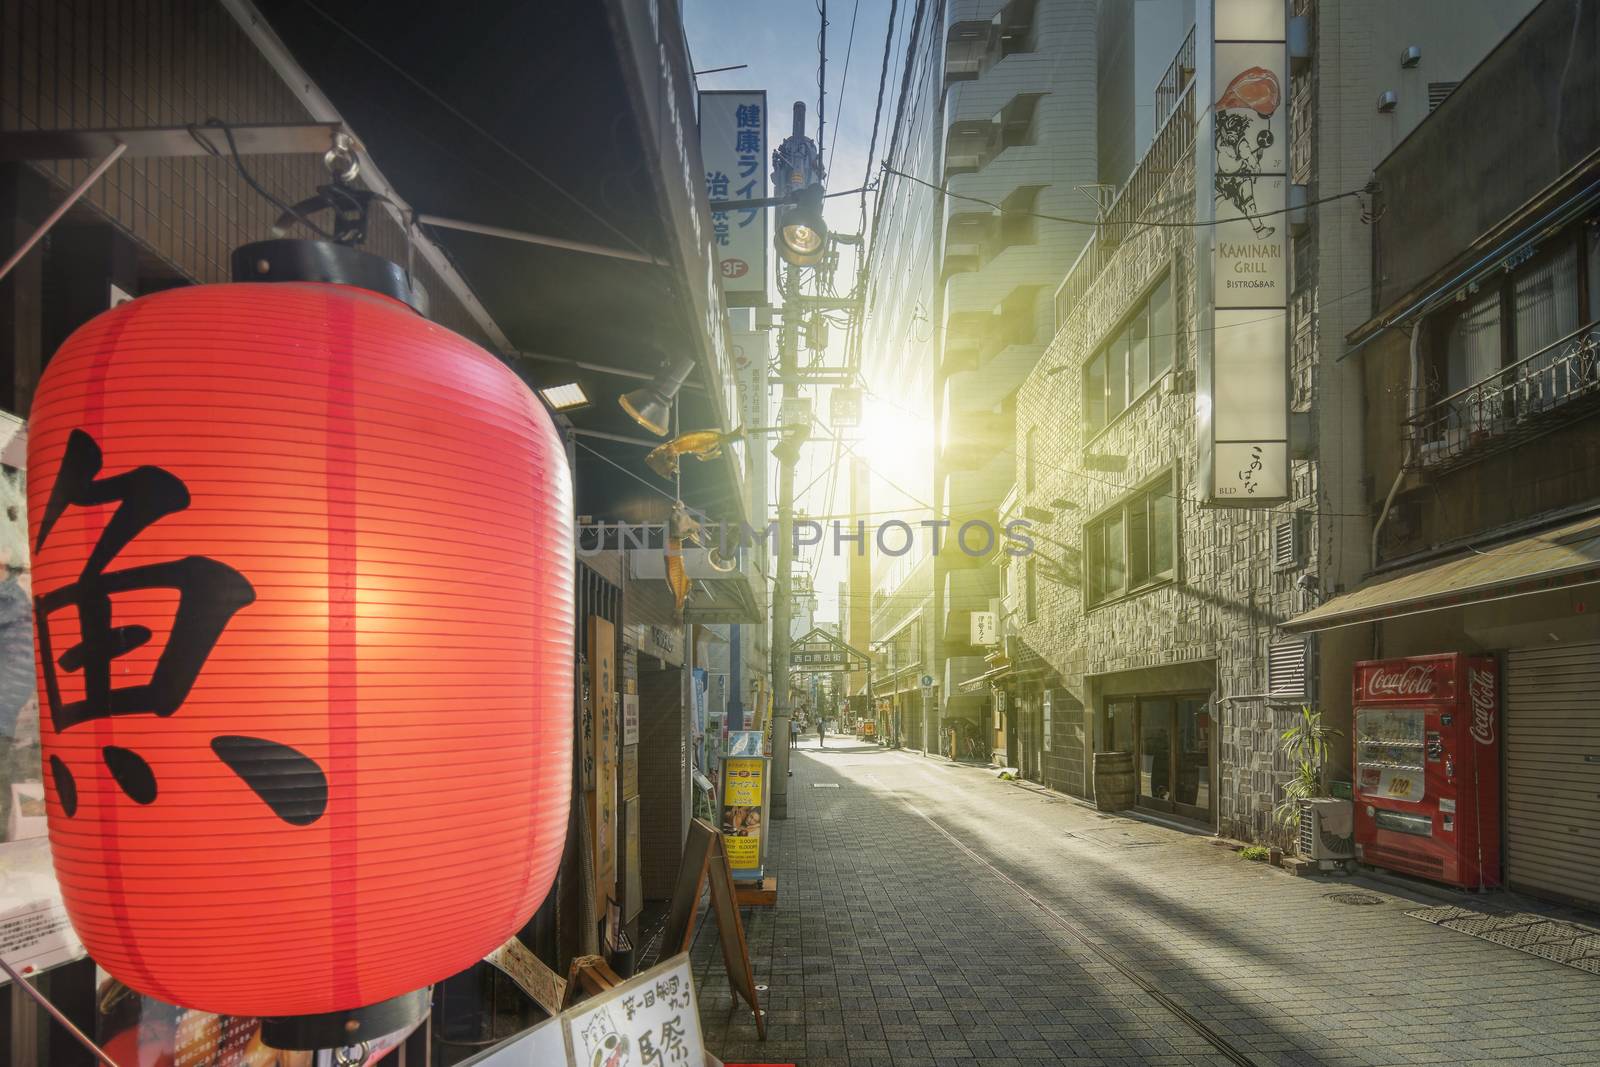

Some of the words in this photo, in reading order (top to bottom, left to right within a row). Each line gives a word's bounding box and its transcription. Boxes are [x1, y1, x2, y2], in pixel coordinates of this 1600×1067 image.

[736, 104, 760, 228] 健康ライフ
[1220, 242, 1281, 258] KAMINARI
[722, 262, 743, 275] 3F
[1234, 261, 1267, 273] GRILL
[1227, 280, 1275, 289] BISTRO&BAR
[35, 428, 328, 827] 魚
[794, 653, 841, 663] 西口商店街
[1369, 665, 1438, 695] Coca-Cola
[1388, 777, 1410, 794] 100
